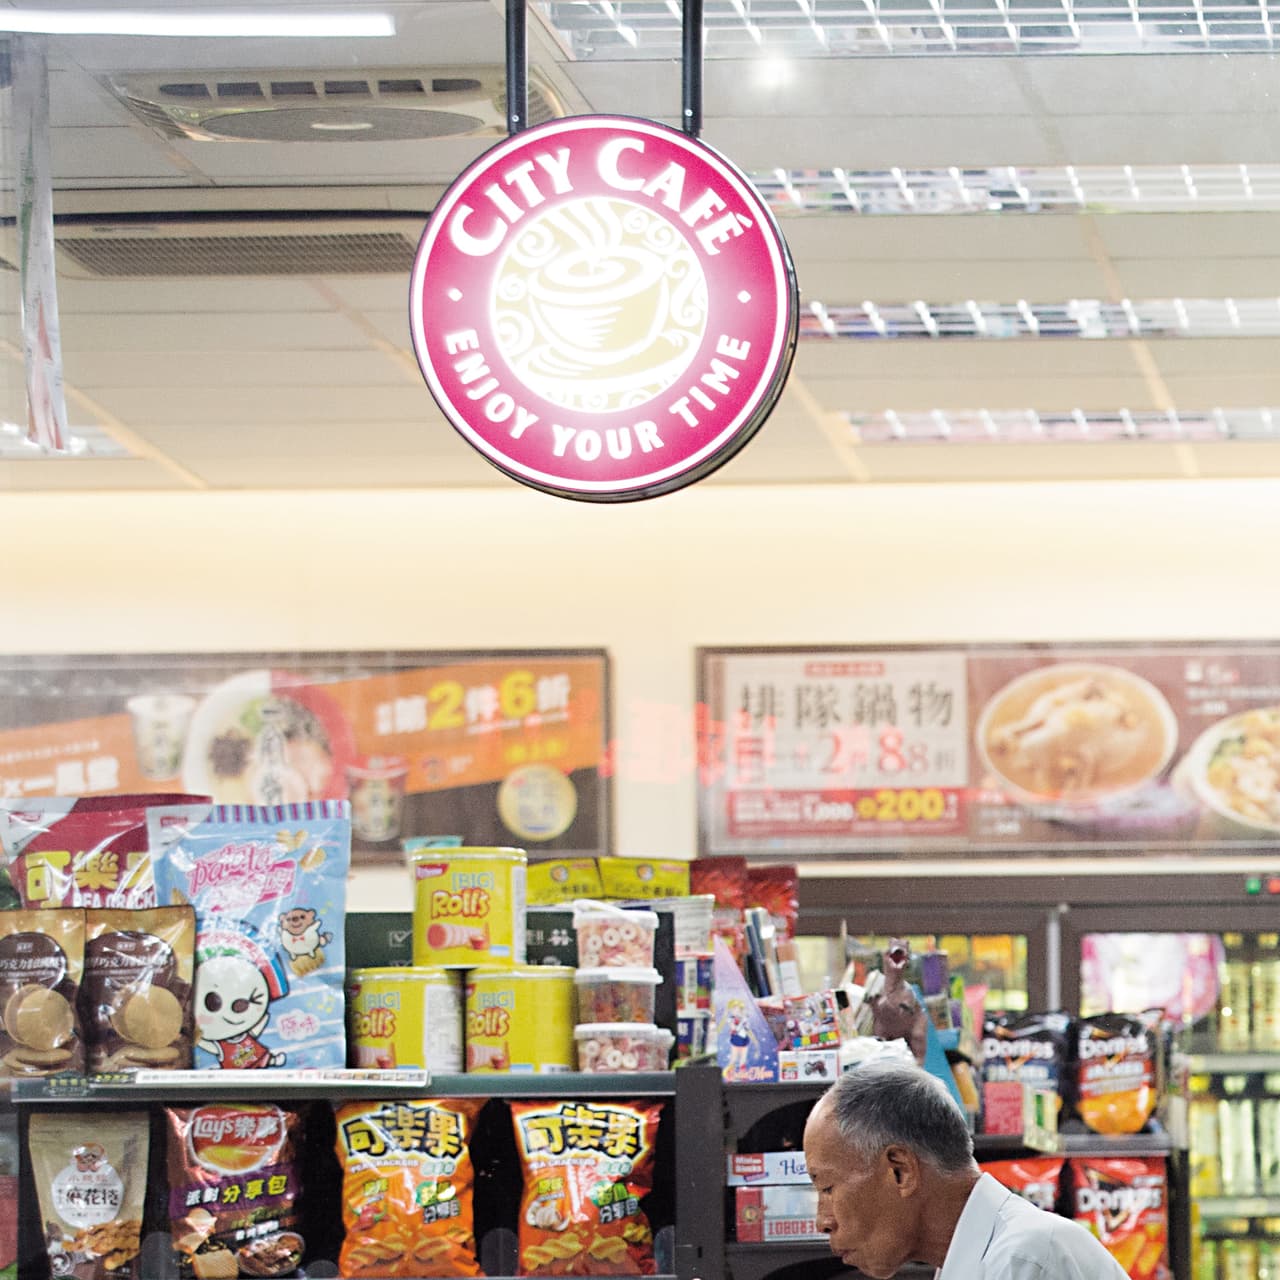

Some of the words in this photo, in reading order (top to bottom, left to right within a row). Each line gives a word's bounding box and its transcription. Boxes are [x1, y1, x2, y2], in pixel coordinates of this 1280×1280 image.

[450, 147, 574, 257] CITY
[597, 138, 753, 257] CAFÉ
[446, 329, 540, 440] ENJOY
[551, 421, 665, 462] YOUR
[669, 333, 752, 428] TIME
